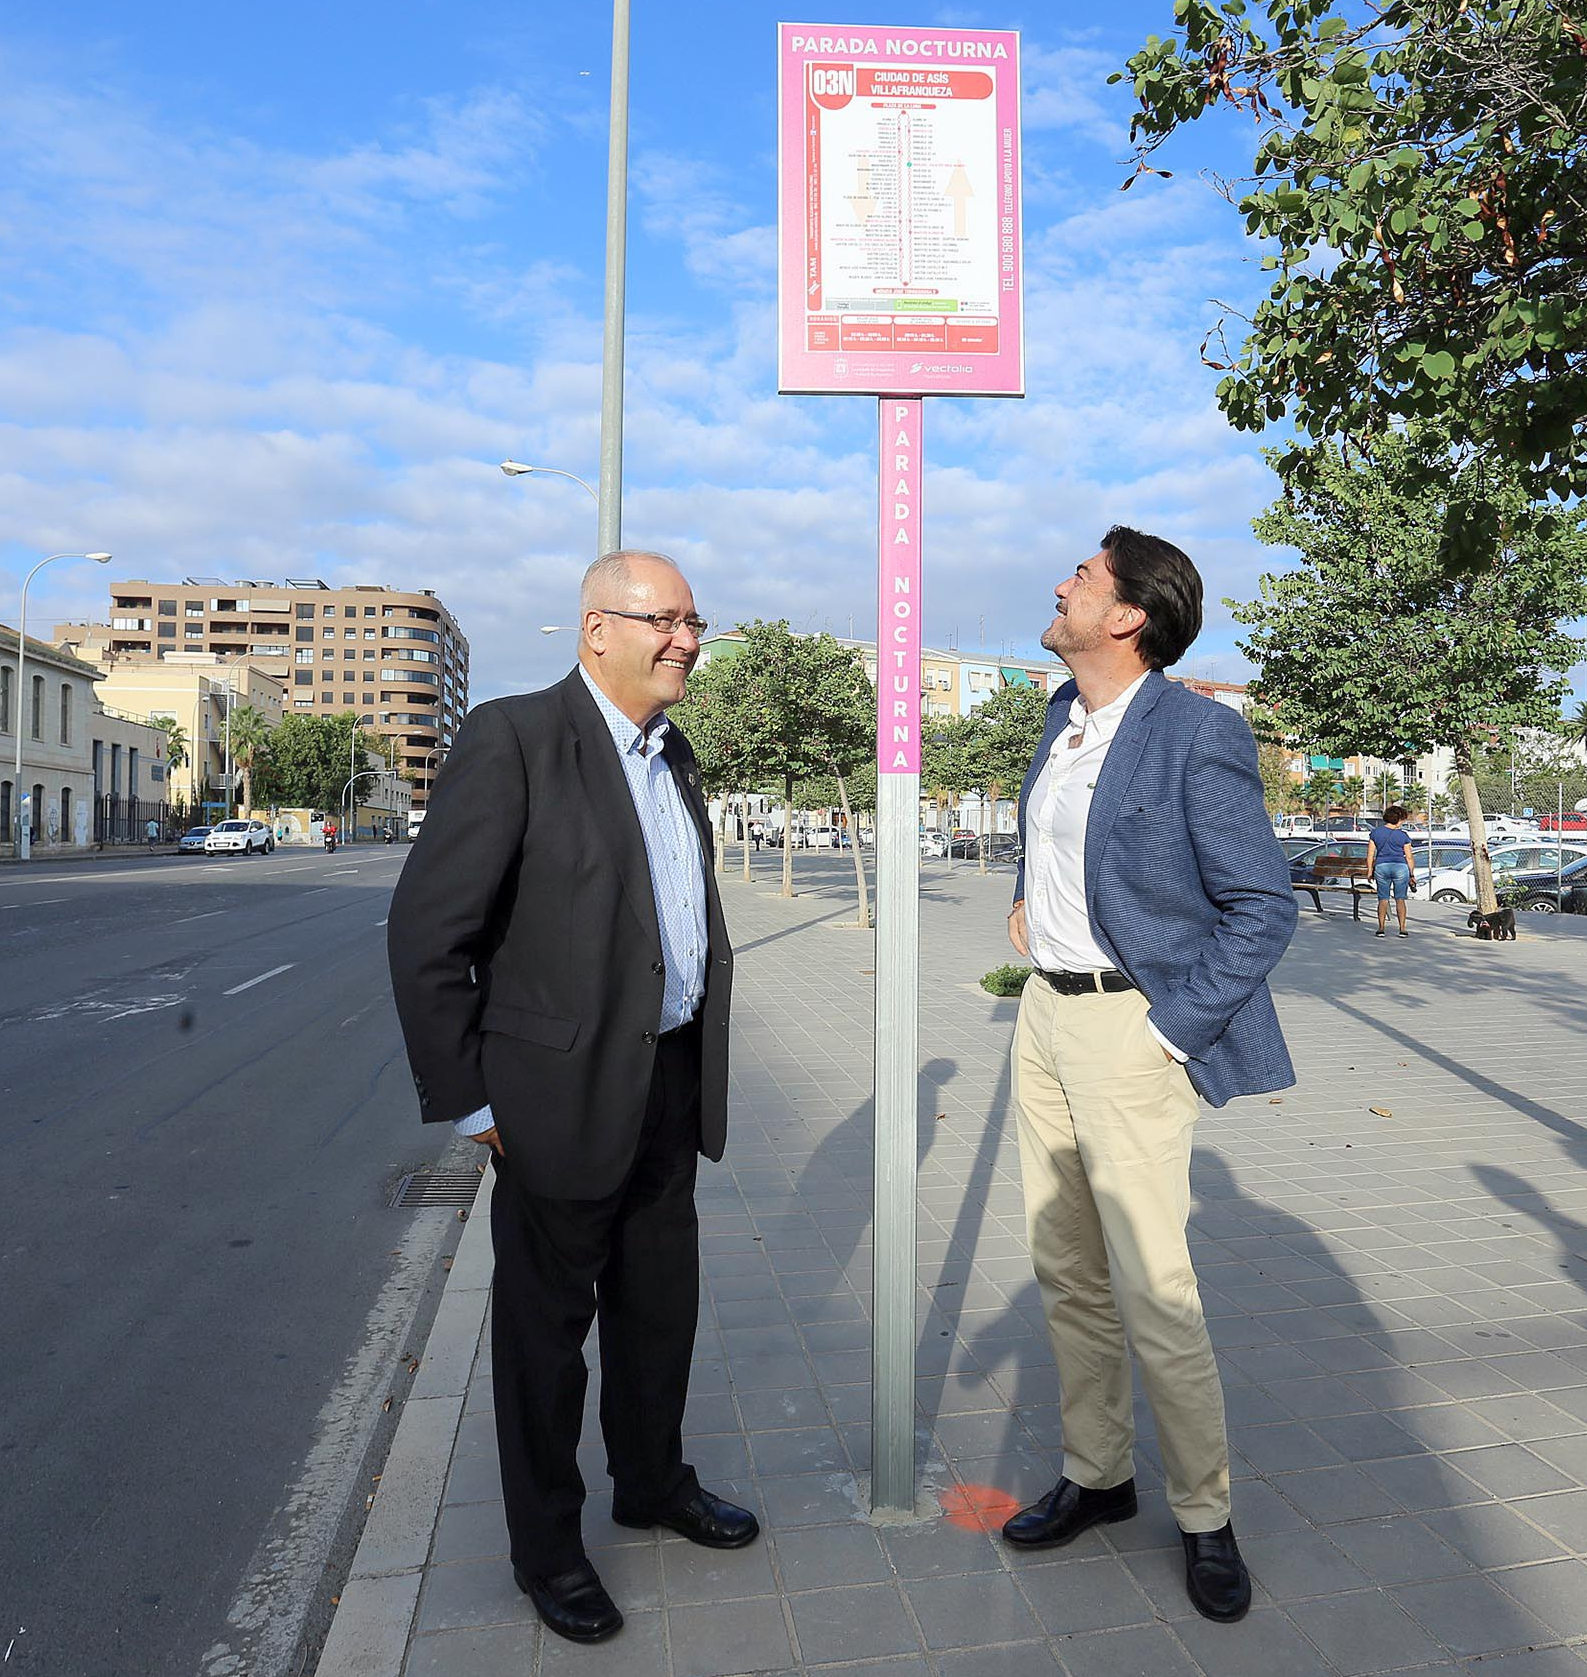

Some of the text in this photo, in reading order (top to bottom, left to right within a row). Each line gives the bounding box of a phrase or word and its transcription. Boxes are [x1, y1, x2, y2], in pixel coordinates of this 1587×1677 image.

[791, 36, 1009, 59] PARADA NOCTURNA
[813, 69, 853, 96] 03N
[874, 71, 949, 84] CIUDAD DE ASÍS
[870, 84, 953, 97] VILLAFRANQUEZA
[1003, 128, 1012, 148] MUJER
[1003, 149, 1012, 157] LA
[1003, 163, 1013, 184] APOYO
[1001, 216, 1013, 234] 888
[1002, 236, 1014, 253] 580
[809, 256, 817, 278] TAM
[1002, 255, 1014, 272] 900
[1002, 274, 1014, 292] TEL.
[924, 364, 973, 373] vectalia
[893, 406, 911, 768] PARADA NOCTURNA
